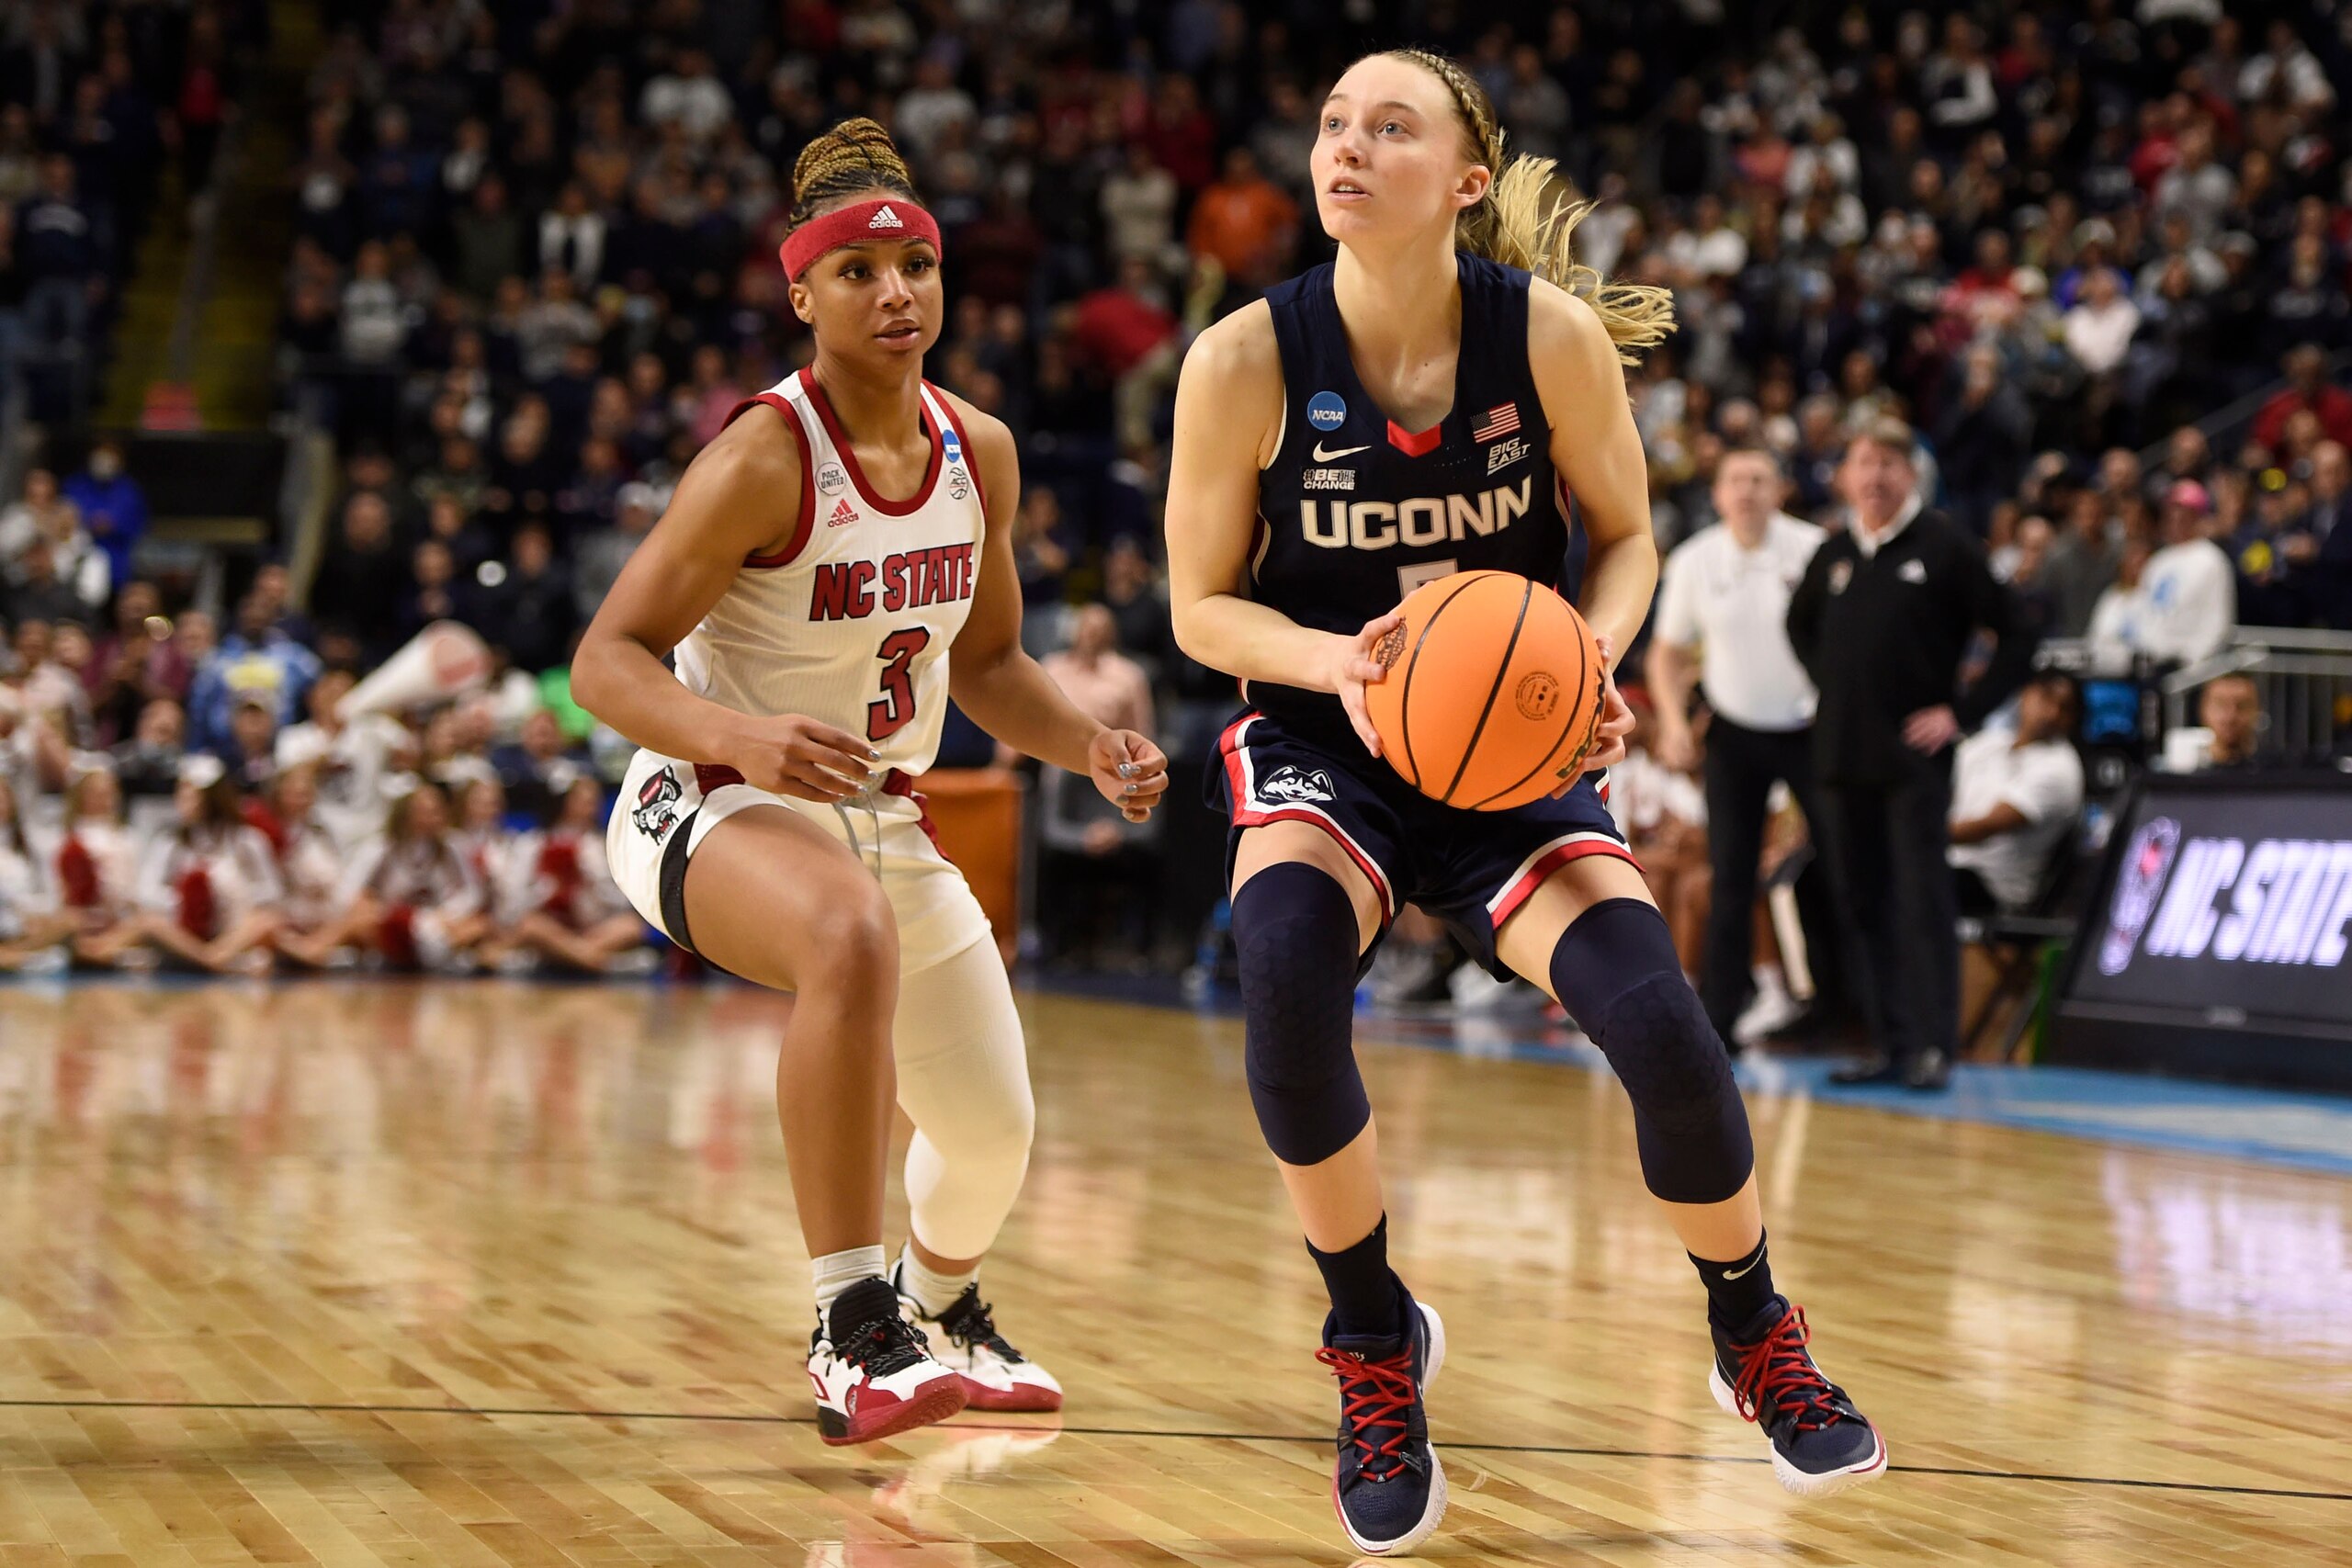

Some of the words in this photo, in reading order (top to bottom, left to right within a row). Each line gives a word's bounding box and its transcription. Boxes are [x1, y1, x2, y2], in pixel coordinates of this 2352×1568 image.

[868, 219, 903, 229] adidas
[1312, 410, 1344, 422] NCAA
[1488, 436, 1521, 458] BIG
[1487, 444, 1531, 469] EAST
[820, 476, 844, 489] UNITED
[821, 469, 841, 480] PACK
[1304, 480, 1355, 491] CHANGE
[828, 513, 859, 528] adidas
[1300, 474, 1532, 551] UCONN
[808, 559, 876, 621] NC
[882, 542, 975, 613] STATE
[866, 626, 931, 742] 3
[2144, 836, 2245, 958] NC
